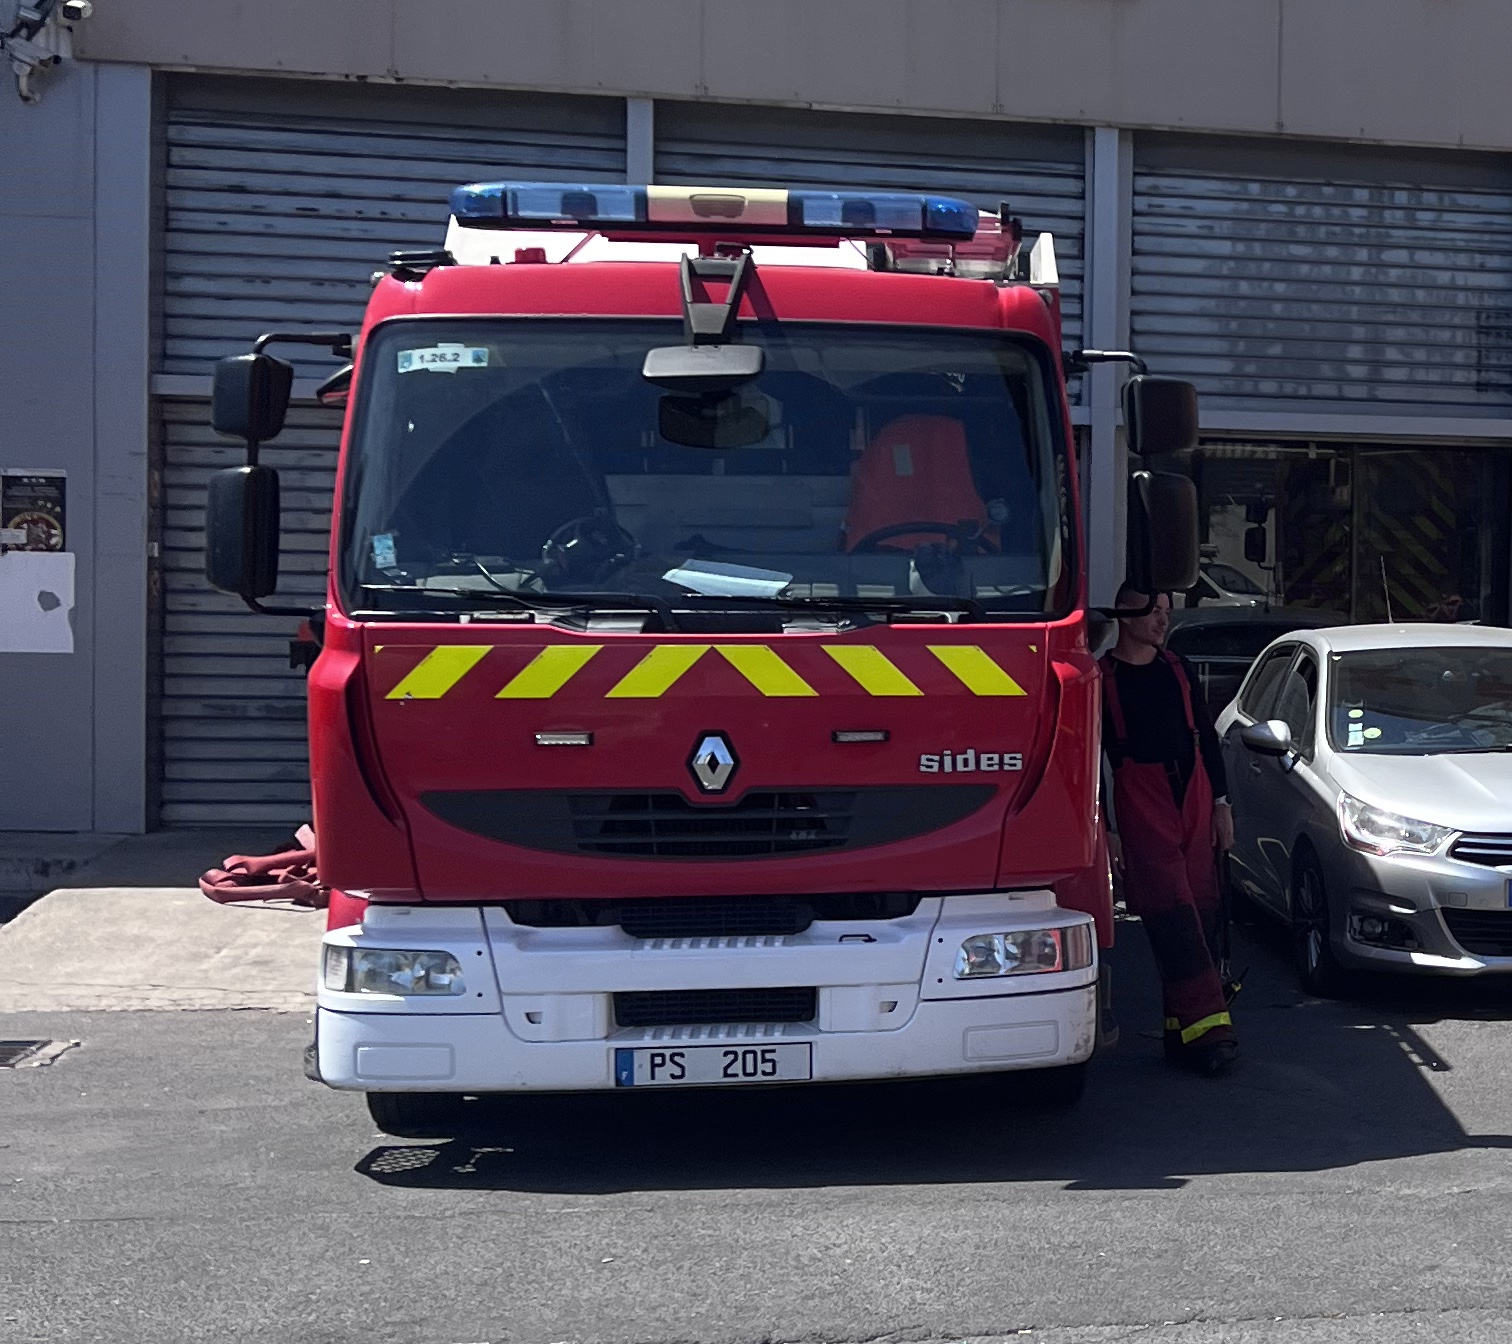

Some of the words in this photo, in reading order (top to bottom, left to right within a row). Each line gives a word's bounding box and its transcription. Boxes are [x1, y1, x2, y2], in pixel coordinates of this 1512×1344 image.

[919, 748, 1023, 773] sides
[650, 1051, 686, 1081] PS
[722, 1048, 777, 1078] 205
